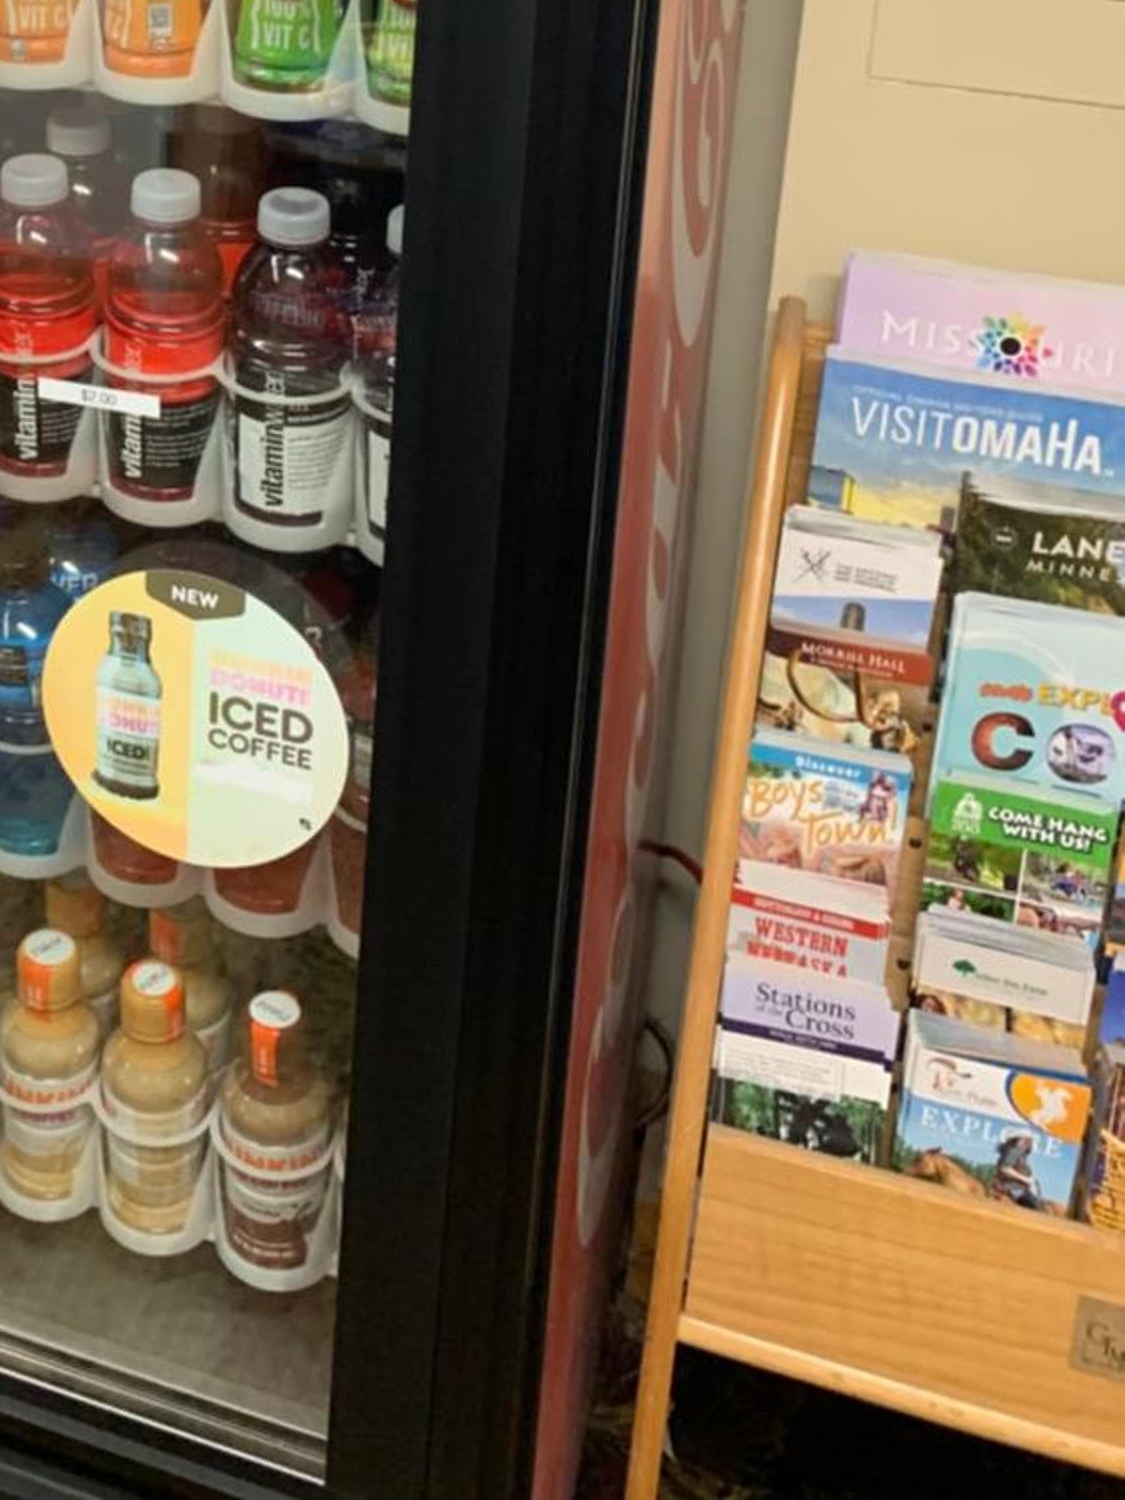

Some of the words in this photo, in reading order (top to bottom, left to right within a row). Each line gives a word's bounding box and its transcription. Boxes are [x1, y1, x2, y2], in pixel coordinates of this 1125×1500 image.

[171, 584, 219, 609] NEW
[208, 691, 314, 745] ICED
[207, 727, 312, 771] COFFEE
[749, 778, 824, 822] Boys
[795, 811, 893, 856] Town
[987, 805, 1044, 828] COME
[1048, 816, 1108, 842] HANG
[1002, 822, 1055, 844] WITH
[1060, 833, 1092, 853] US!
[755, 916, 849, 957] WESTERN
[756, 981, 857, 1022] Stations
[784, 1008, 856, 1040] Cross
[921, 1105, 1065, 1157] EXPLE
